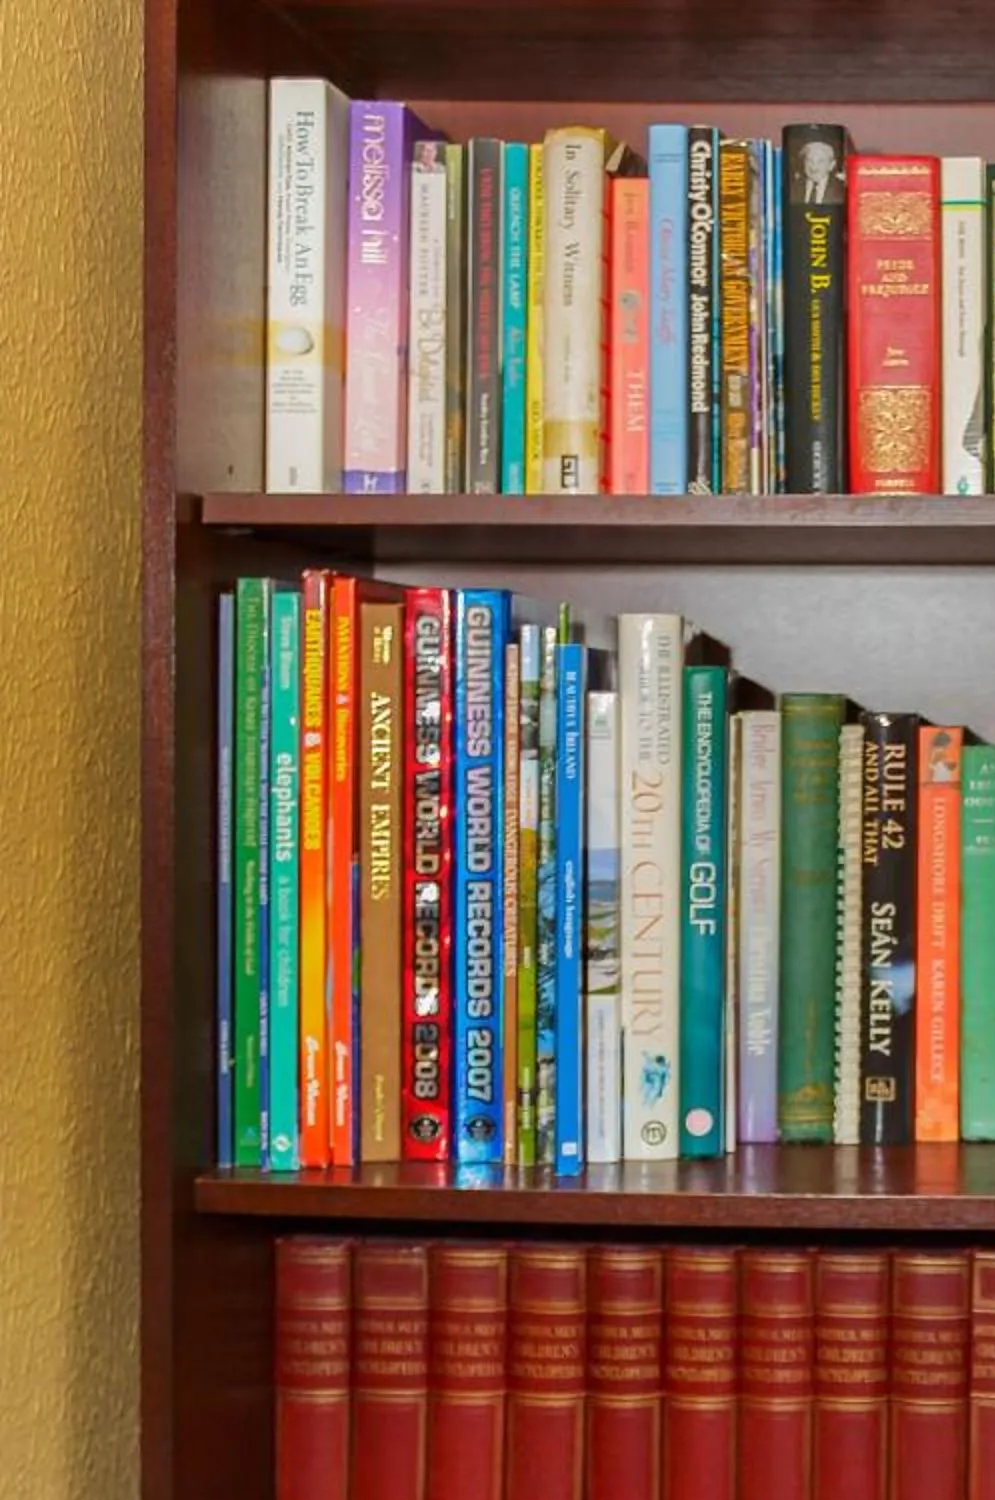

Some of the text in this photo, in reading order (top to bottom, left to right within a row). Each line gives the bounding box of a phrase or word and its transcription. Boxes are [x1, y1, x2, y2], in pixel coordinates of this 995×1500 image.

[289, 111, 315, 307] How To Break An Egg
[362, 115, 389, 264] melissa hill
[559, 143, 581, 307] In Solitary Witness
[719, 152, 748, 197] EARLY
[509, 246, 521, 269] THE
[688, 141, 714, 412] Christy O'Connor John Redmond
[719, 203, 748, 276] VICTORIAN
[810, 273, 831, 293] B.
[876, 259, 915, 270] PRIDE
[882, 272, 909, 283] AND
[509, 274, 521, 309] LAMP
[719, 280, 748, 376] GOVERNMENT
[861, 285, 929, 298] PREJUDICE
[626, 369, 644, 432] THEM
[303, 609, 321, 850] EARTHQUAKES & VOLCANOES
[336, 694, 348, 782] & Discoveries
[415, 614, 440, 766] GUINNESS
[656, 665, 670, 765] ILLUSTRATED
[269, 752, 295, 862] elephants
[371, 692, 391, 900] ANCIENT EMPIRES
[415, 770, 440, 876] WORLD
[688, 692, 716, 936] THE ENCYCLOPEDIA OF GOLF
[863, 742, 880, 866] AND ALL THAT
[881, 744, 906, 849] RULE 42
[466, 606, 492, 1101] GUINNESS WORLD RECORDS 2007
[503, 808, 517, 977] DANGEROUS CREATURES
[630, 770, 664, 1040] 20TH CENTURY
[277, 926, 290, 1007] for children
[869, 902, 899, 1057] SEÁN KELLY
[931, 959, 946, 1011] KAREN
[415, 1023, 440, 1098] 2008
[748, 1008, 771, 1056] Noble
